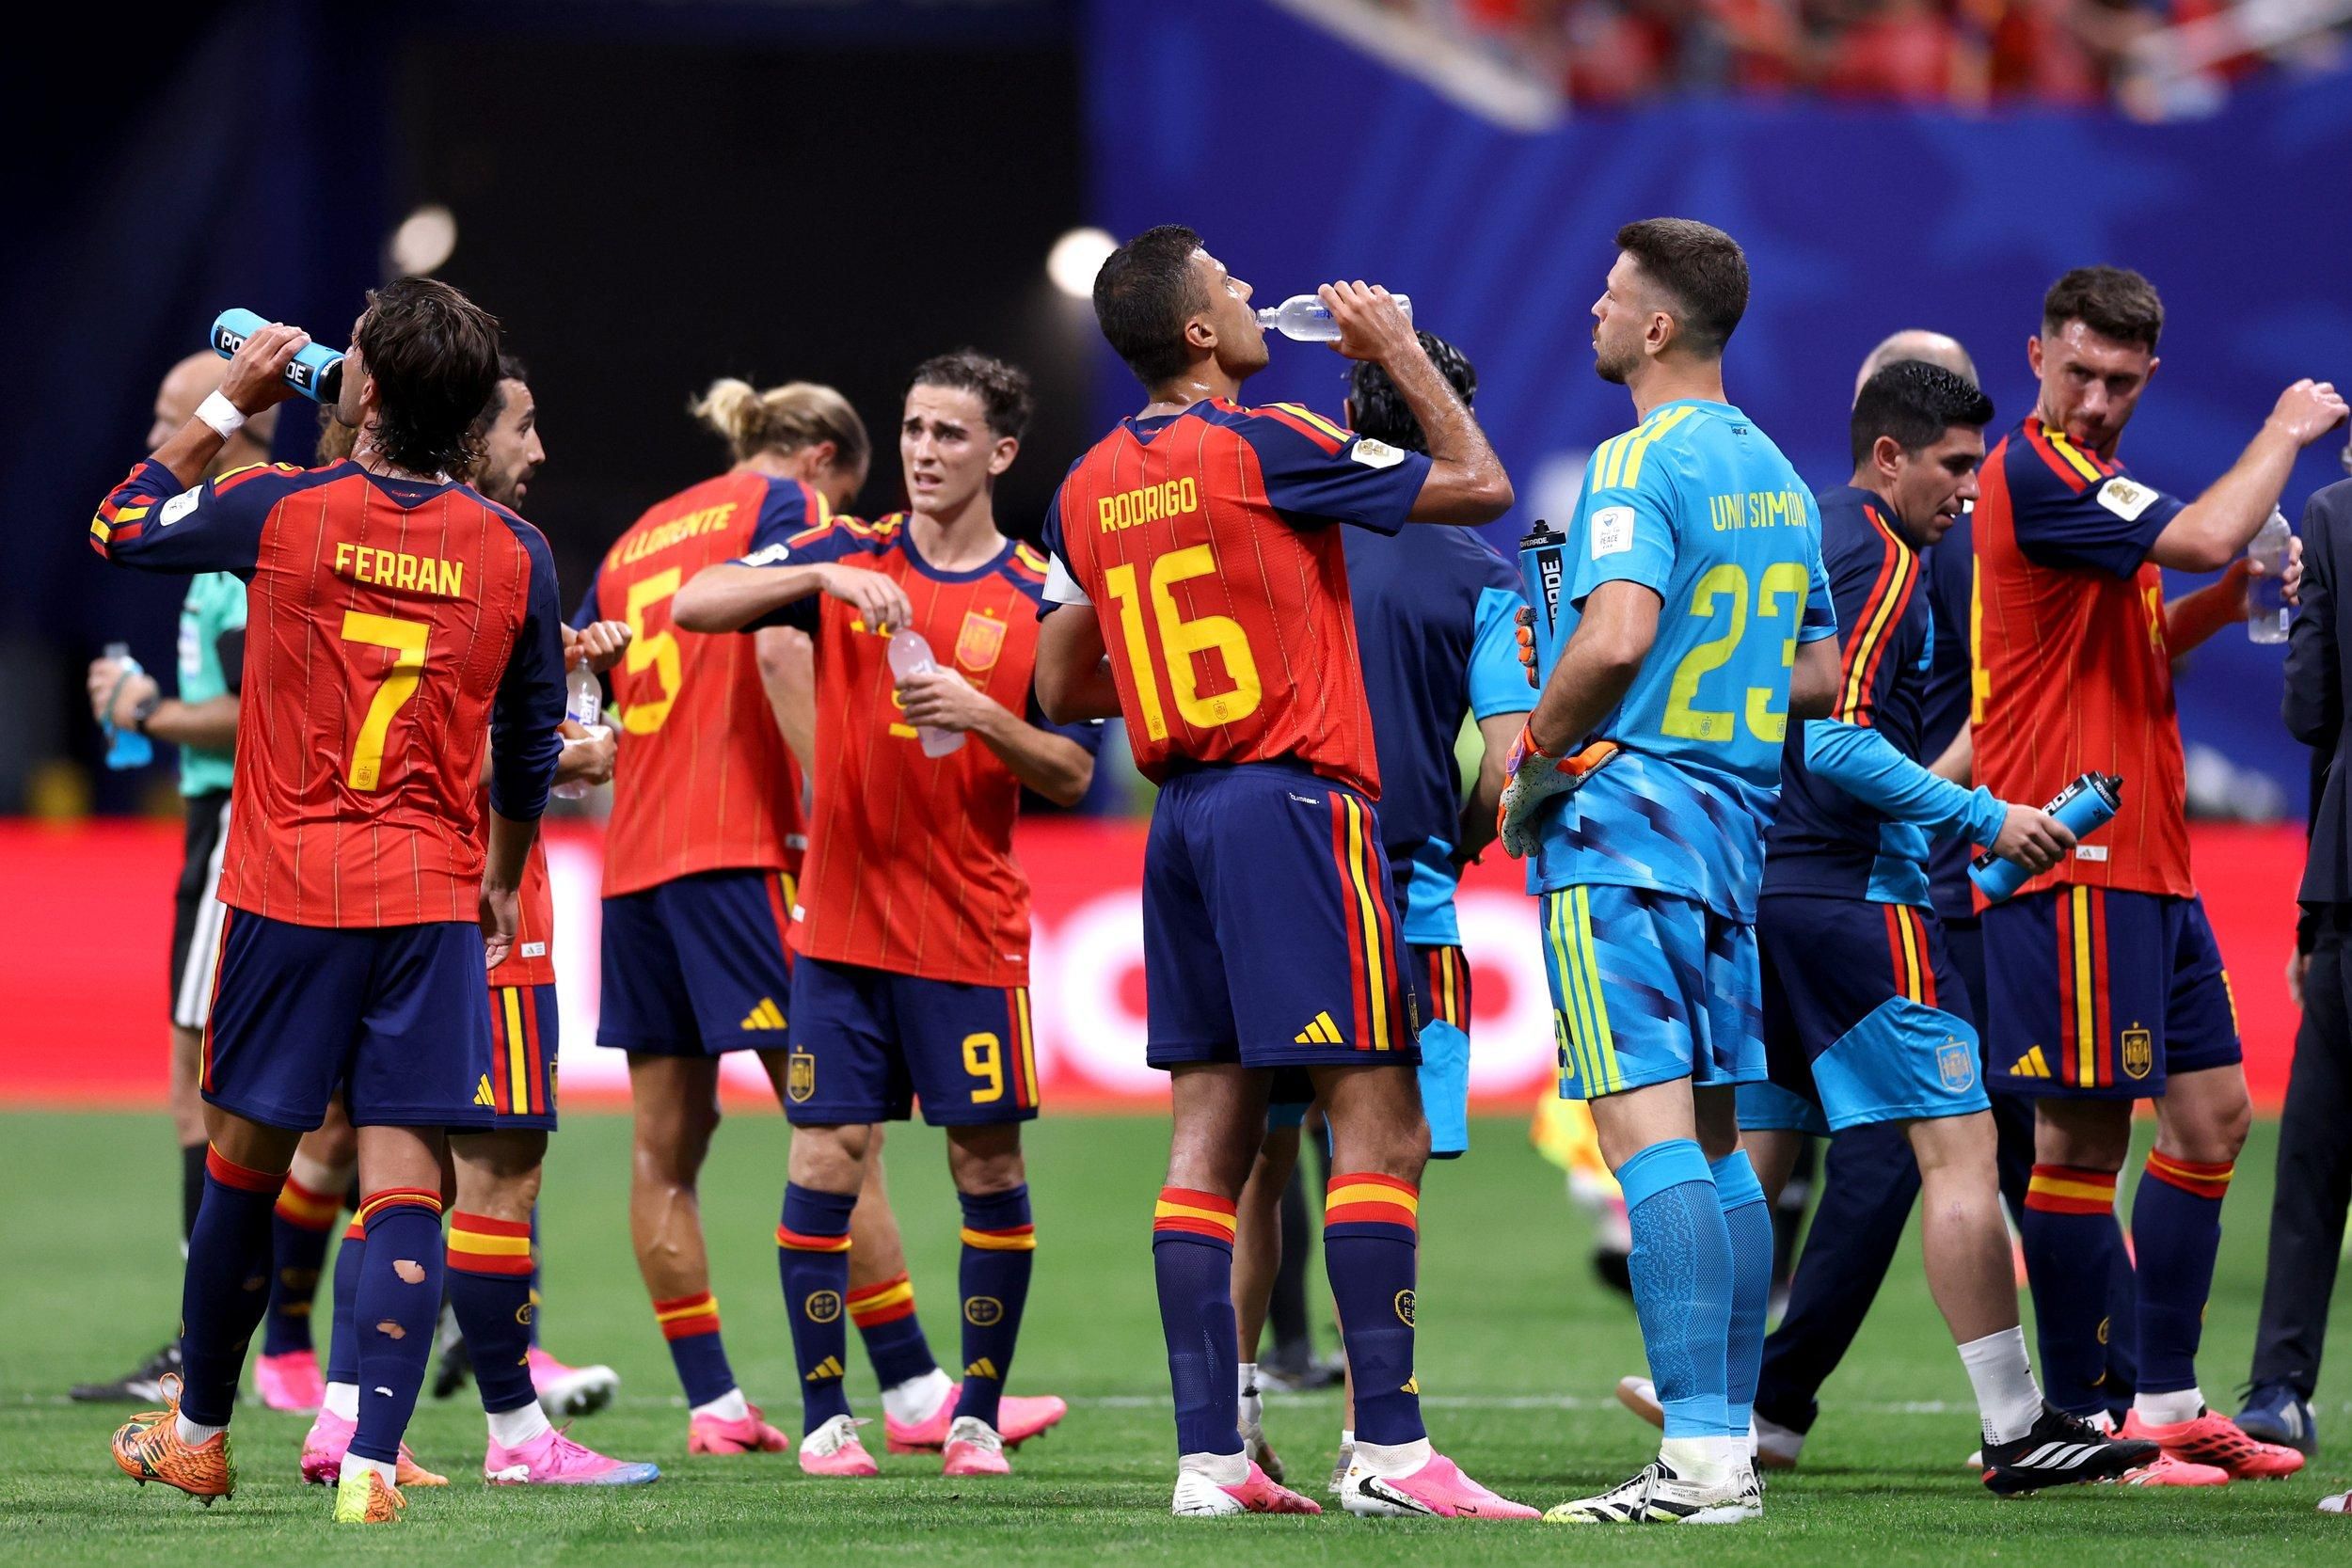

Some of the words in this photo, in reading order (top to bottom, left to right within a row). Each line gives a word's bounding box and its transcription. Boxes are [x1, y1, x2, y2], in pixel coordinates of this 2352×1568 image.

[1098, 477, 1198, 533] RODRIGO
[1749, 483, 1806, 528] SIMÓN
[335, 542, 463, 597] FERRAN
[1519, 536, 1549, 547] OWERADE
[623, 566, 683, 736] 5
[1104, 543, 1263, 742] 16
[1660, 562, 1809, 743] 23
[341, 610, 430, 792] 7
[961, 1031, 1004, 1103] 9
